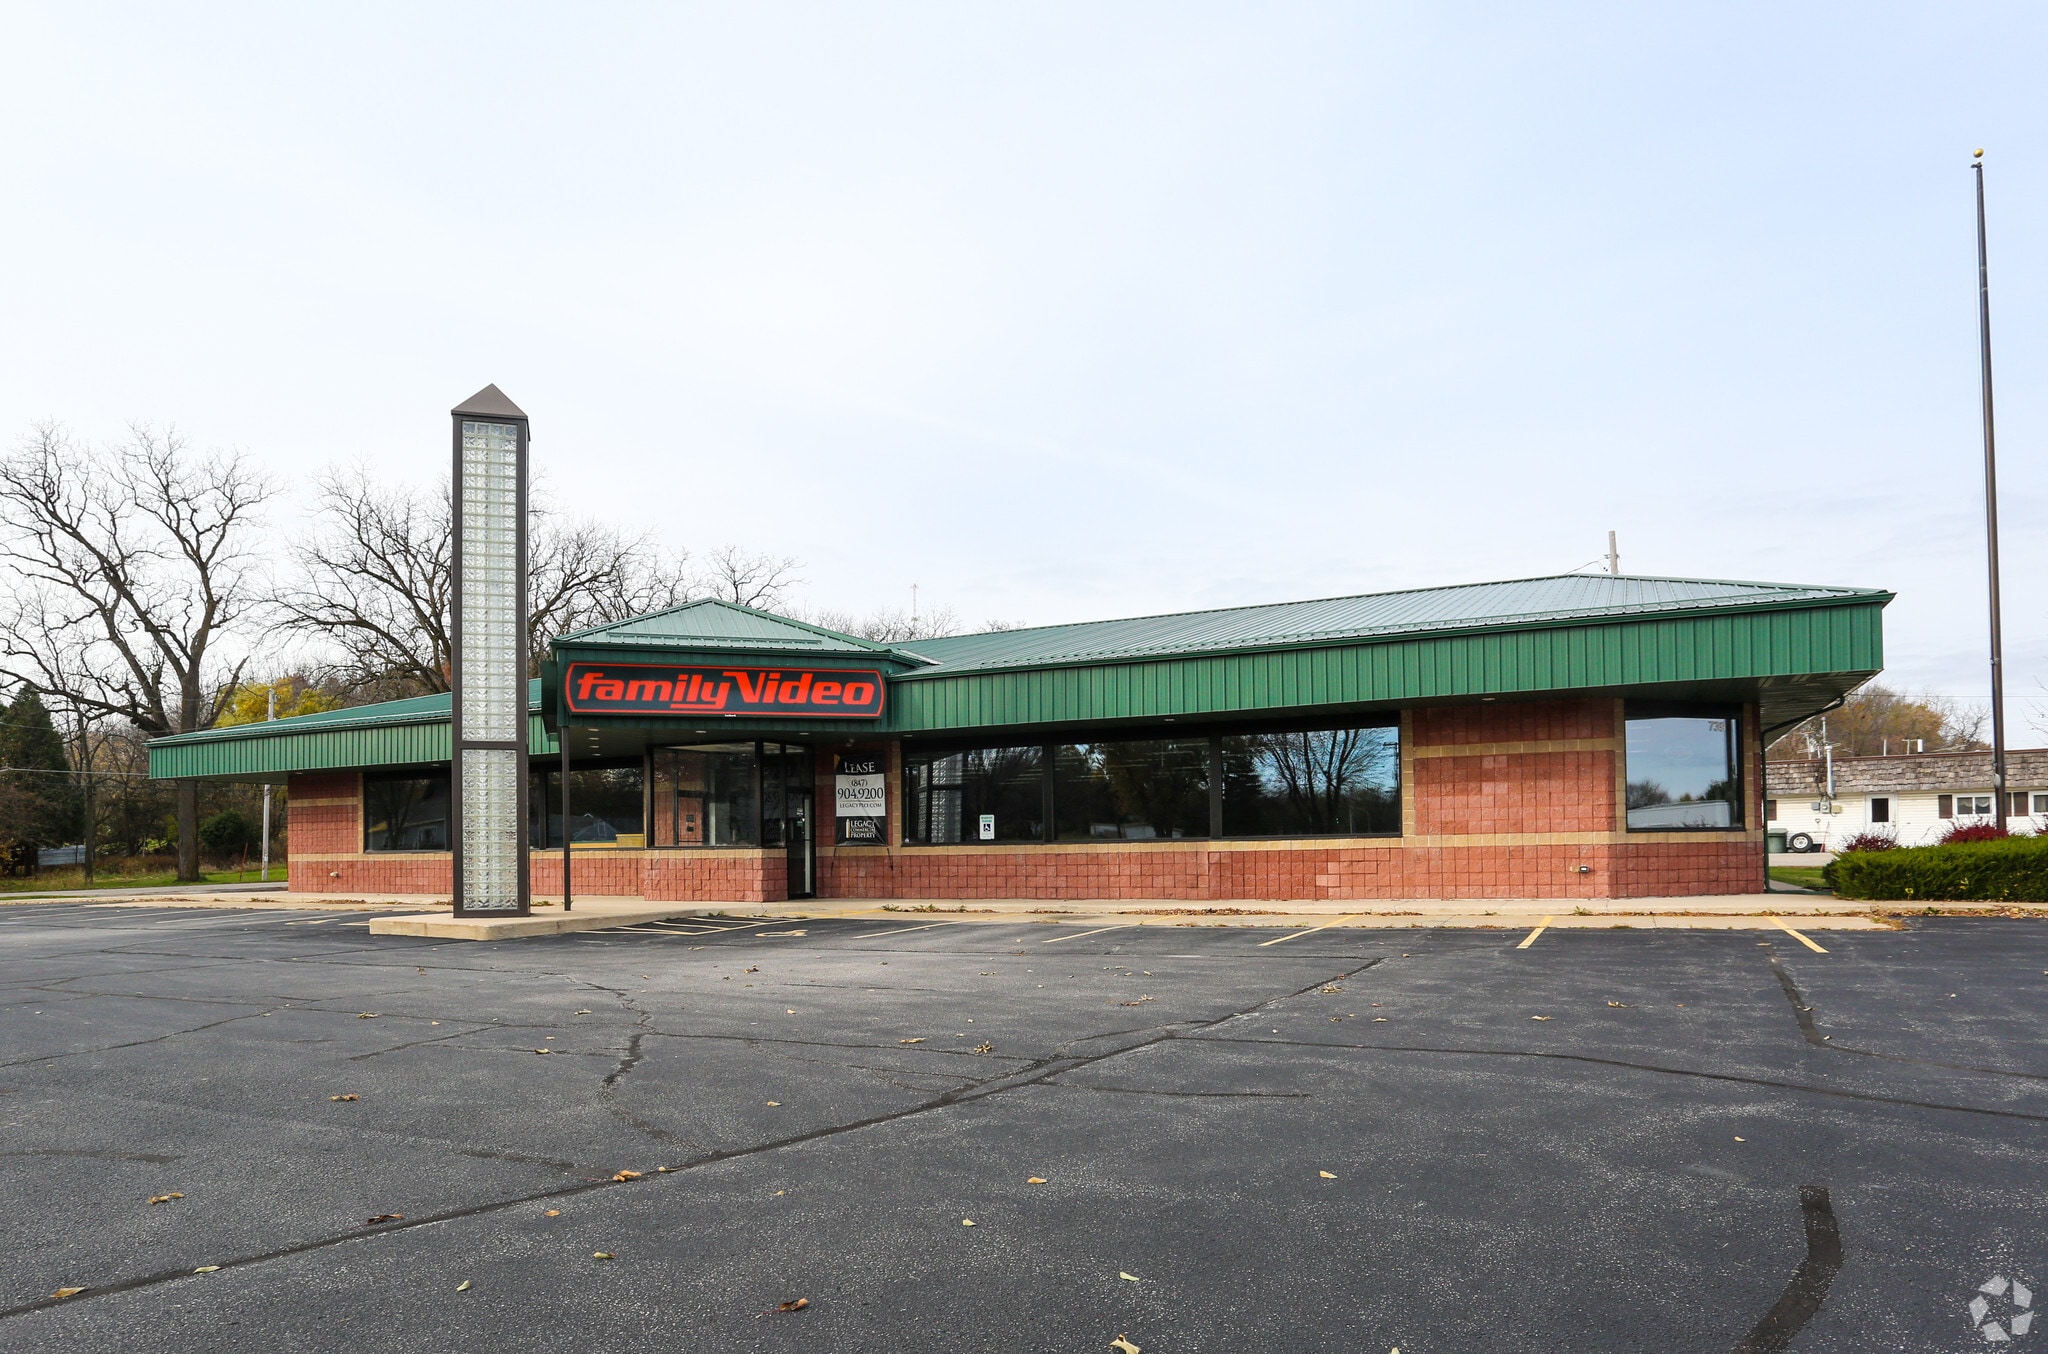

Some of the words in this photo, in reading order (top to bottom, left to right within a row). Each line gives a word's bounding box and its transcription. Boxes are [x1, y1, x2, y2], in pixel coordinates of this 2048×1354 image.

[577, 672, 730, 709] family
[722, 672, 875, 705] Video
[844, 762, 875, 773] LEASE
